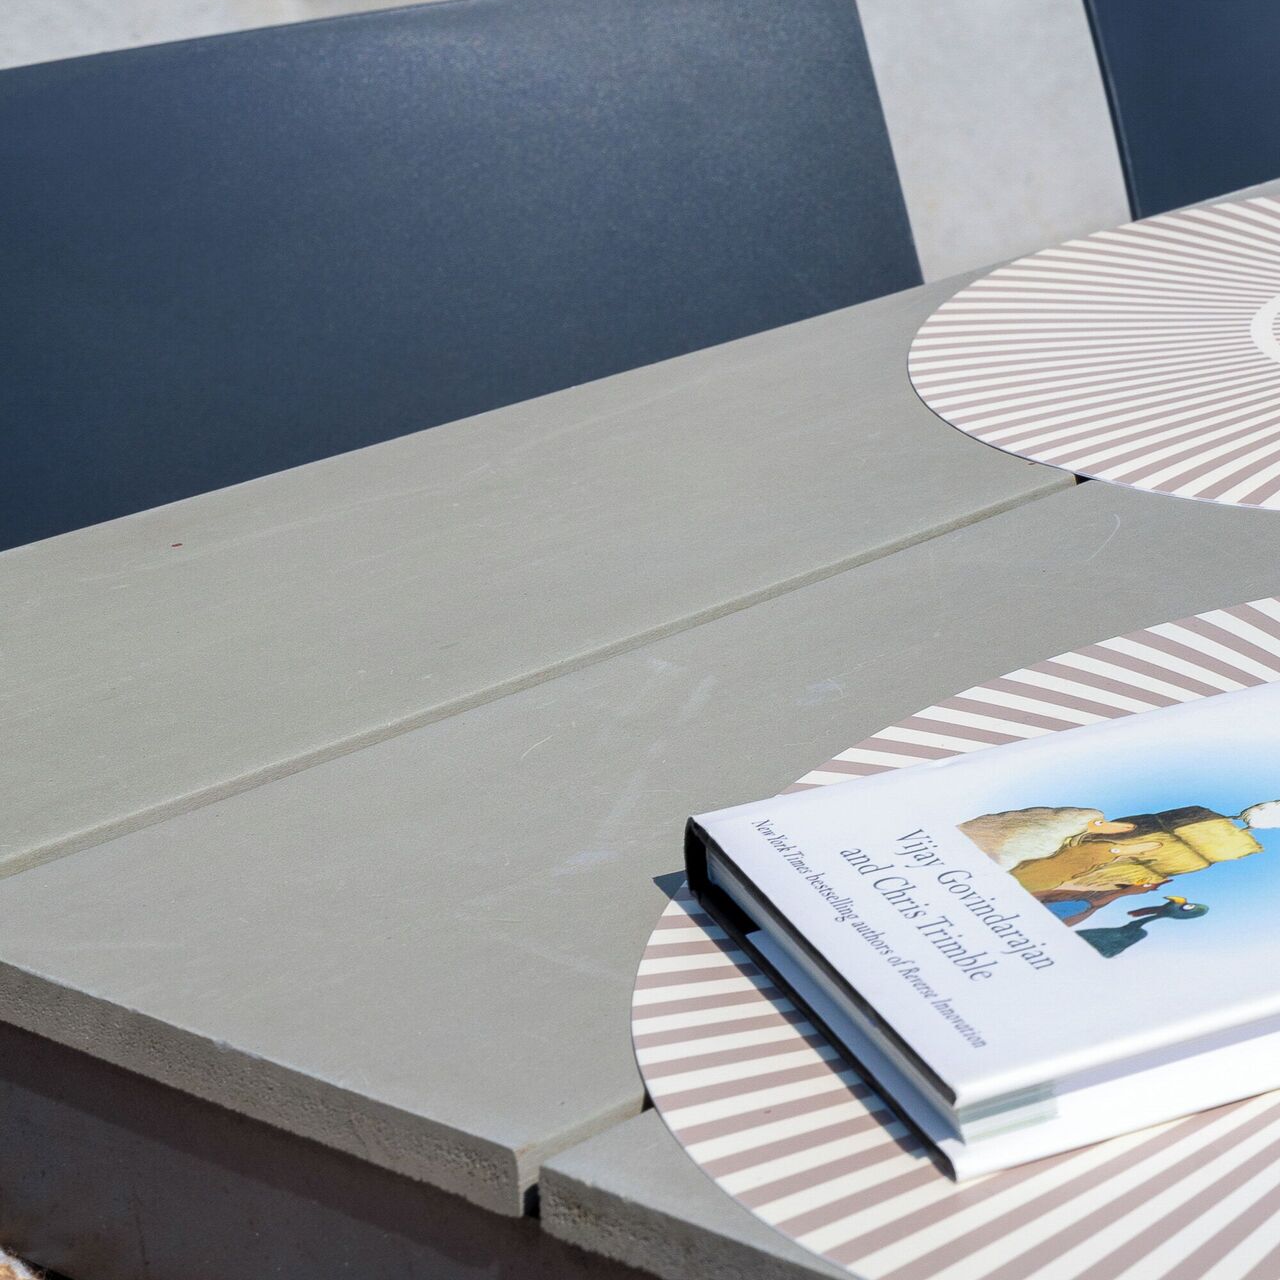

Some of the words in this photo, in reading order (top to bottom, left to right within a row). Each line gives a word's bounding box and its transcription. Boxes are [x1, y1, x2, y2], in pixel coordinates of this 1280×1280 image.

[752, 819, 776, 836] New
[767, 834, 798, 852] York
[784, 850, 812, 874] Times
[805, 872, 859, 922] bestselling
[895, 828, 946, 870] Vijay
[936, 869, 1056, 972] Govindarajan
[840, 847, 895, 877] and
[872, 876, 928, 921] Chris
[916, 915, 998, 983] Trimble
[851, 922, 894, 956] authors
[886, 956, 916, 967] of
[898, 966, 938, 998] Reverse
[930, 998, 988, 1048] Innovation
